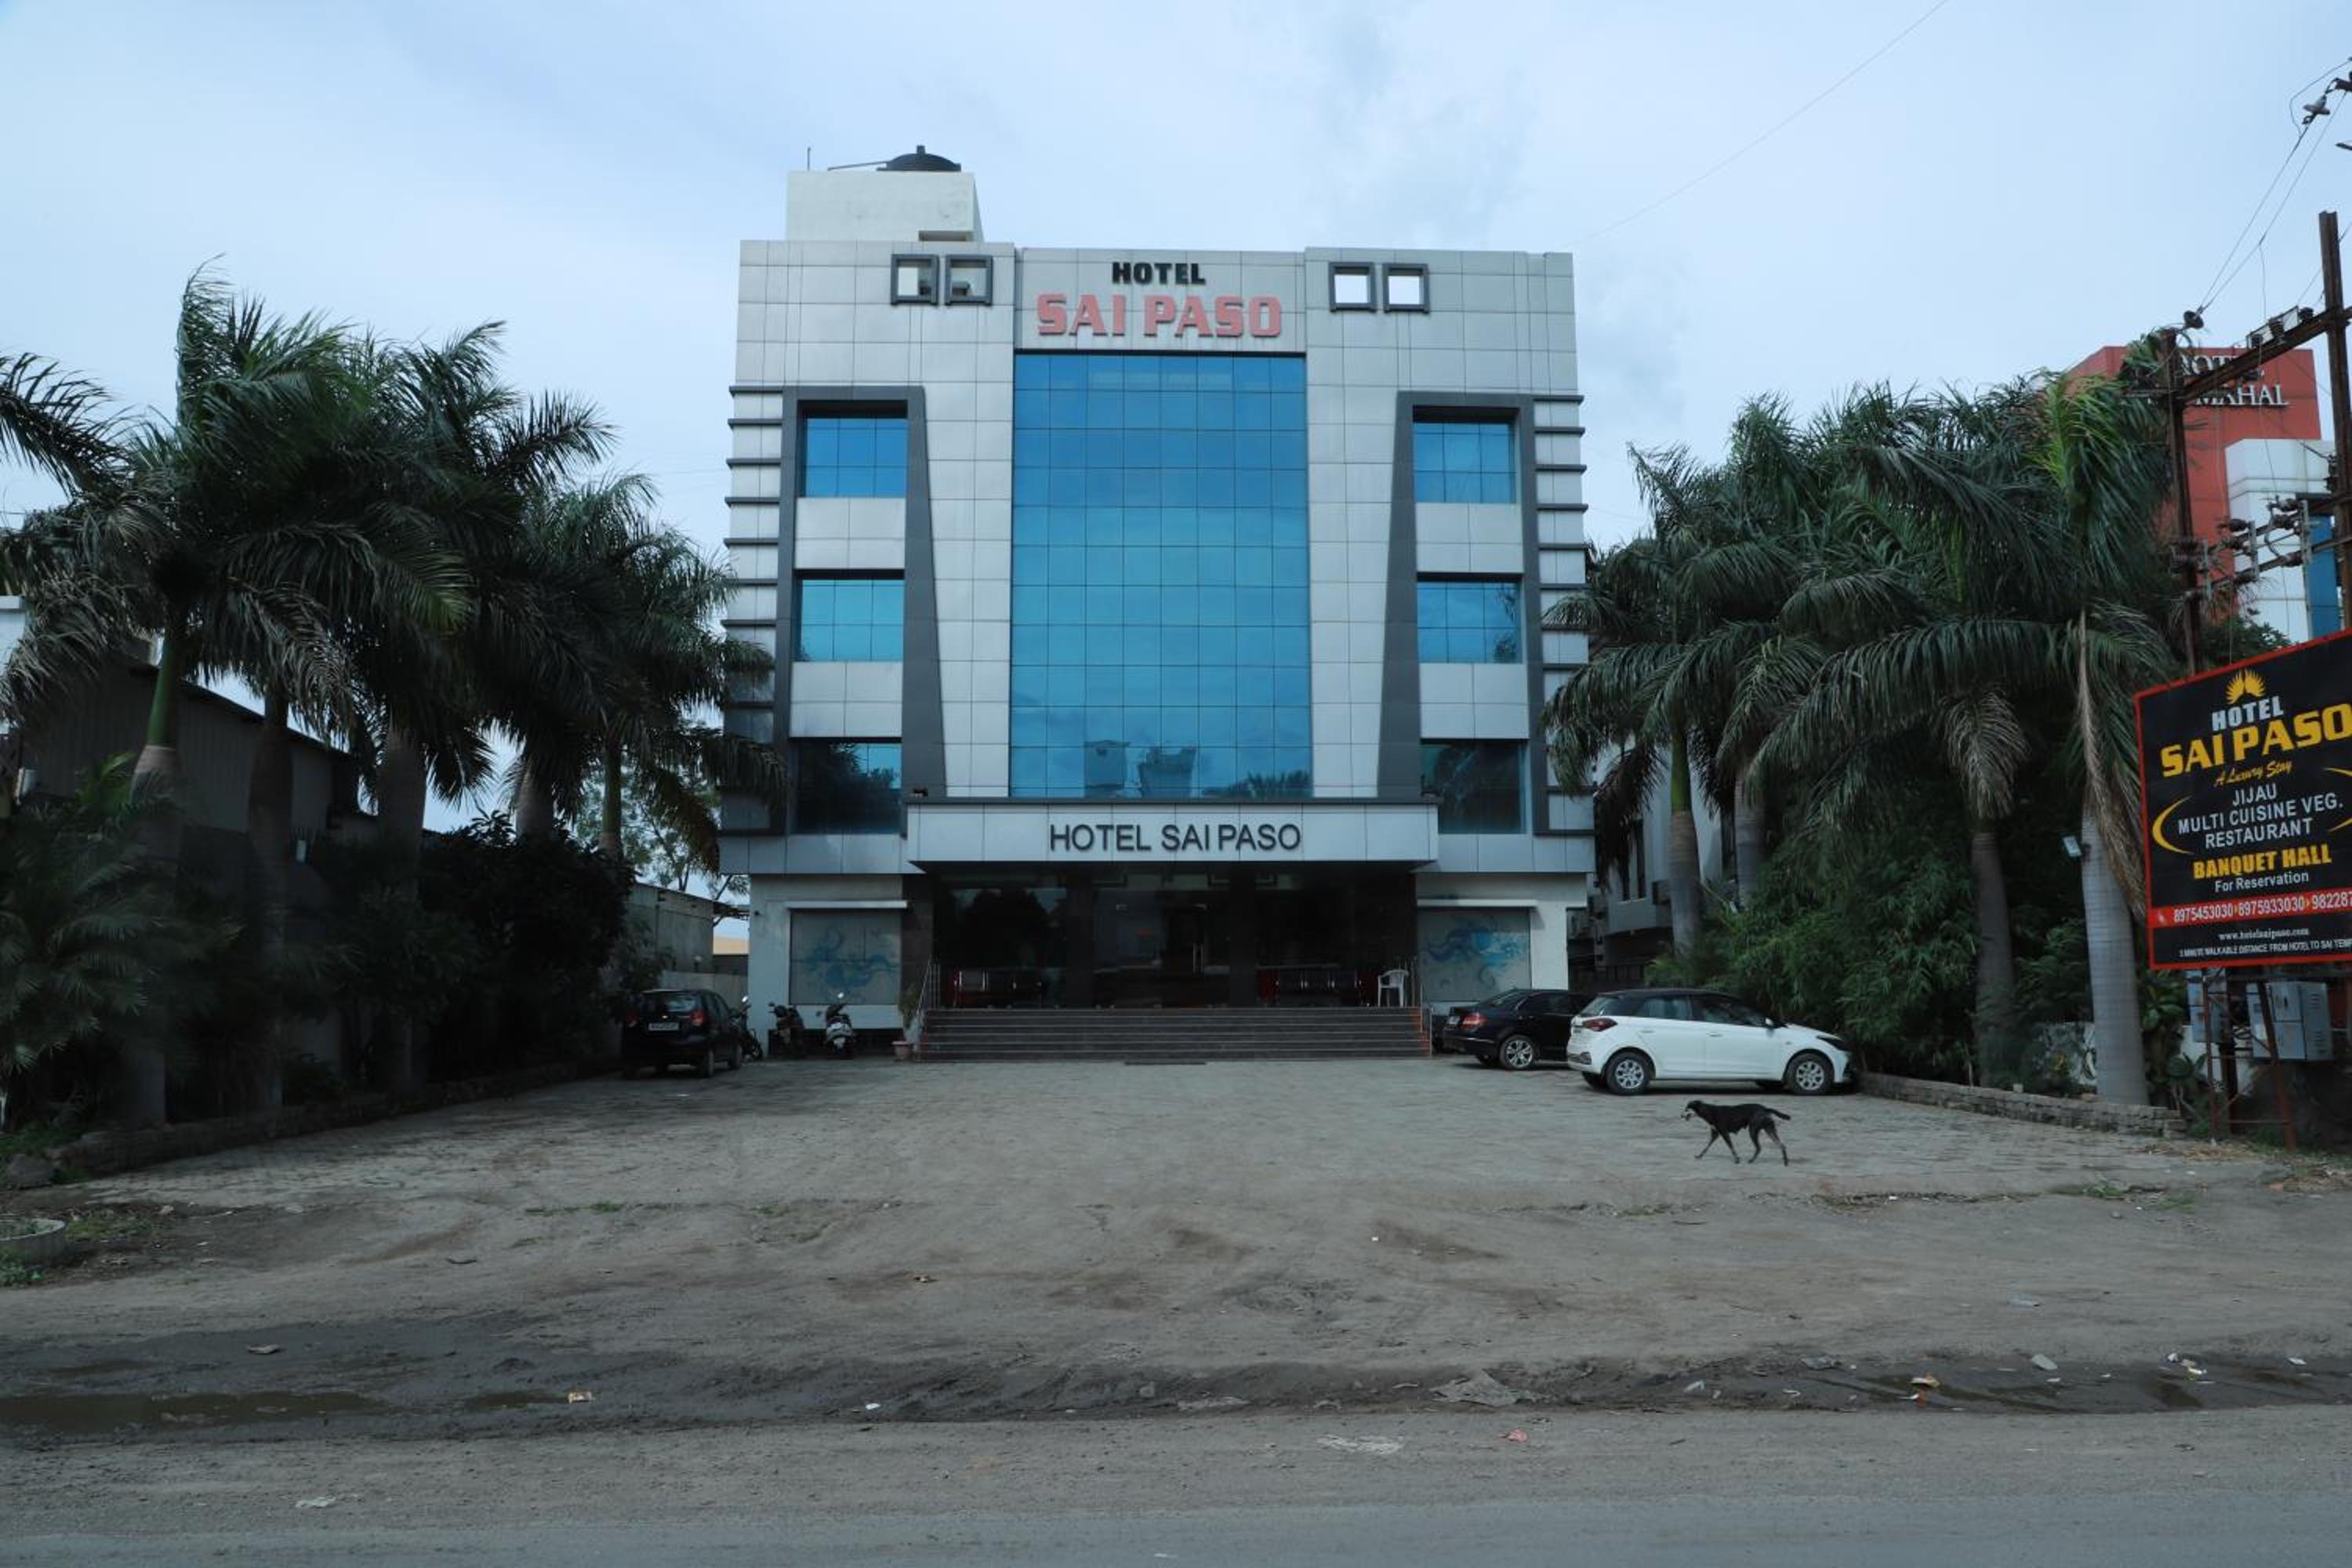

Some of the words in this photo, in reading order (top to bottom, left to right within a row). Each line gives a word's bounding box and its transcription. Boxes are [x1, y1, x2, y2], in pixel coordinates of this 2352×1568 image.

[1112, 262, 1206, 285] HOTEL
[1037, 294, 1126, 336] SAI
[1143, 295, 1281, 338] PASO
[2212, 696, 2283, 731] HOTEL
[2160, 735, 2224, 778] SAI
[2233, 703, 2352, 761] PASO
[2233, 783, 2277, 807] JIJAU
[2178, 812, 2223, 835] MULTI
[2230, 800, 2296, 824] CUISINE
[2301, 792, 2343, 813] VEG.
[1050, 823, 1151, 851] HOTEL
[1161, 823, 1210, 851] SAI
[1218, 823, 1301, 851] PASO
[2205, 818, 2312, 849] RESTAURANT
[2194, 851, 2277, 879] BANQUET
[2282, 844, 2332, 868] HALL
[2215, 880, 2233, 893] For
[2236, 872, 2309, 891] Reservation
